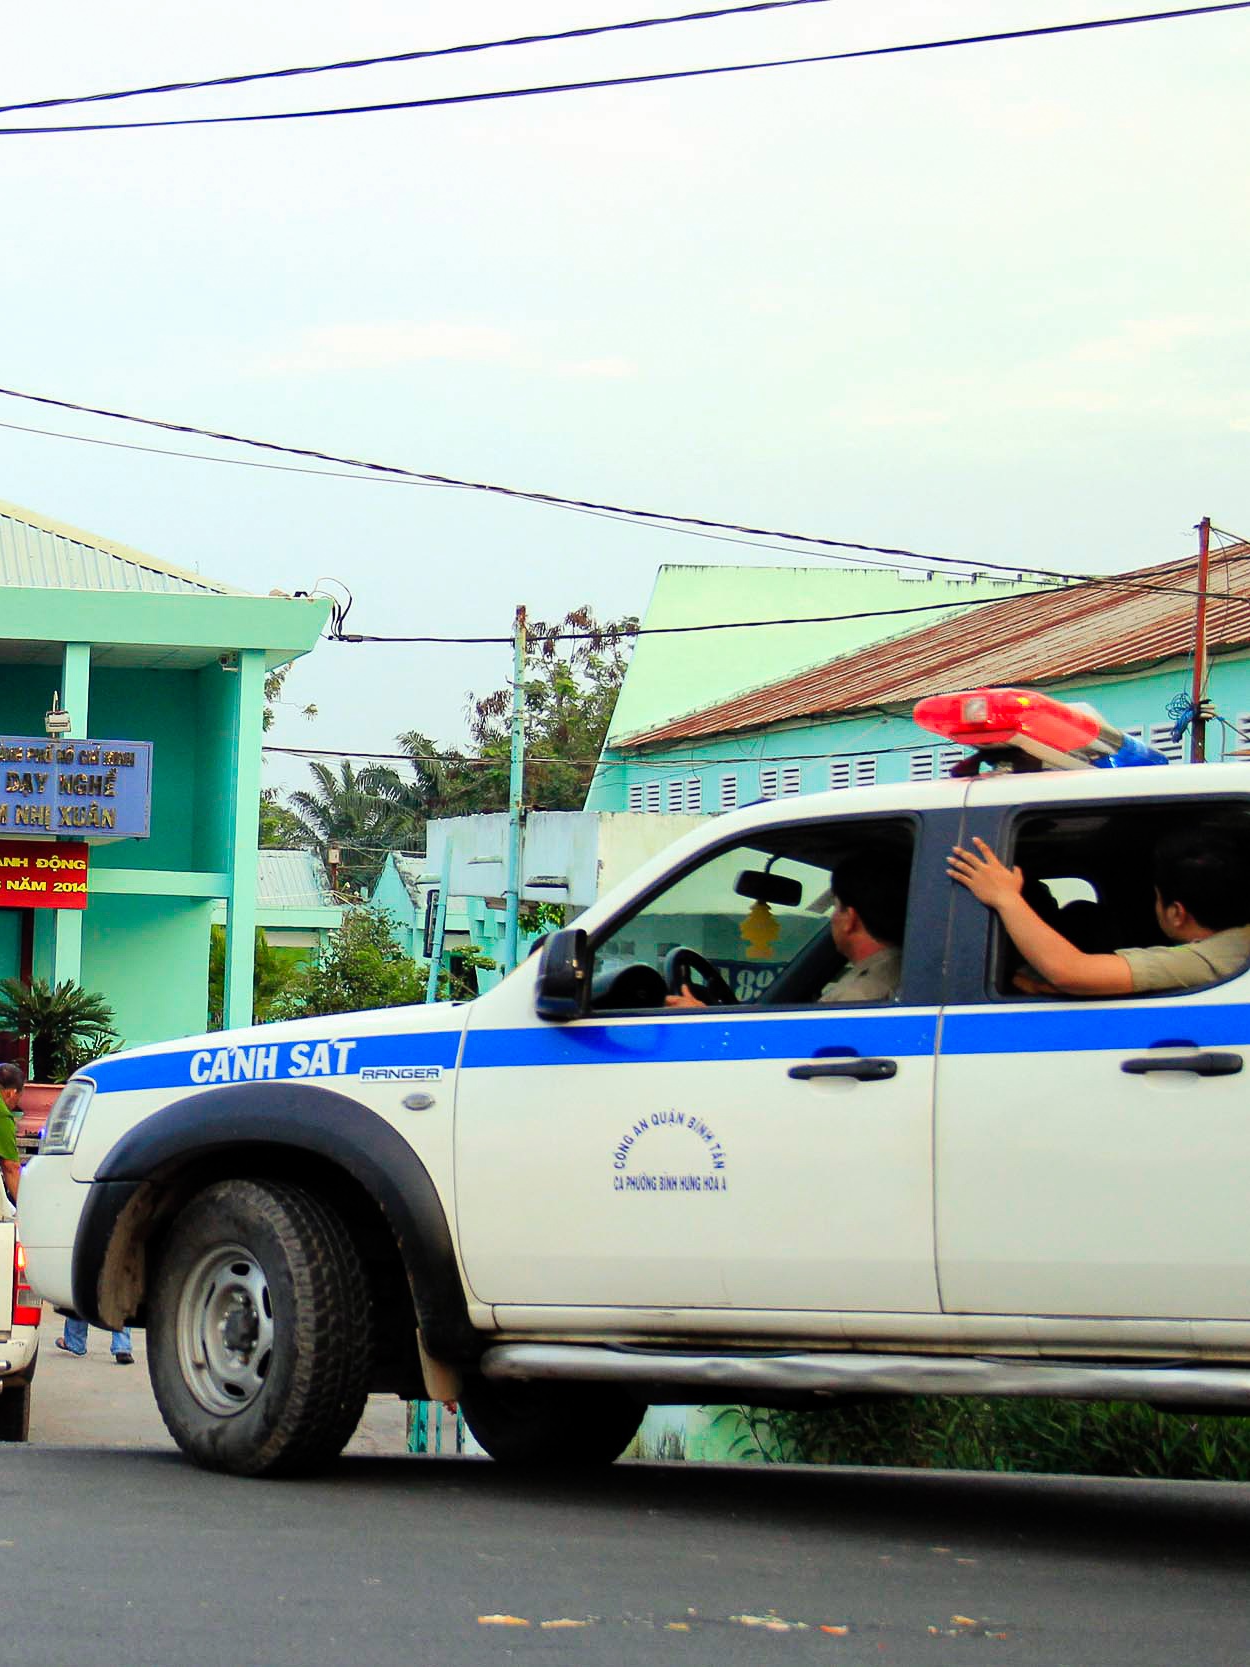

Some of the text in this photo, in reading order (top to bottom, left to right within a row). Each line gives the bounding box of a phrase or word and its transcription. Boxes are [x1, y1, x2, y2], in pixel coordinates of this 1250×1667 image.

[5, 771, 49, 797] DẠY
[58, 767, 118, 798] NGHỀ
[15, 803, 52, 831] NHỊ
[57, 801, 117, 829] XUÂN
[35, 854, 87, 872] ĐỘNG
[6, 876, 47, 891] NĂM
[52, 882, 88, 893] 2014
[189, 1037, 357, 1084] CẢNH SÁT
[361, 1067, 440, 1081] RANGER
[632, 1118, 649, 1137] AN
